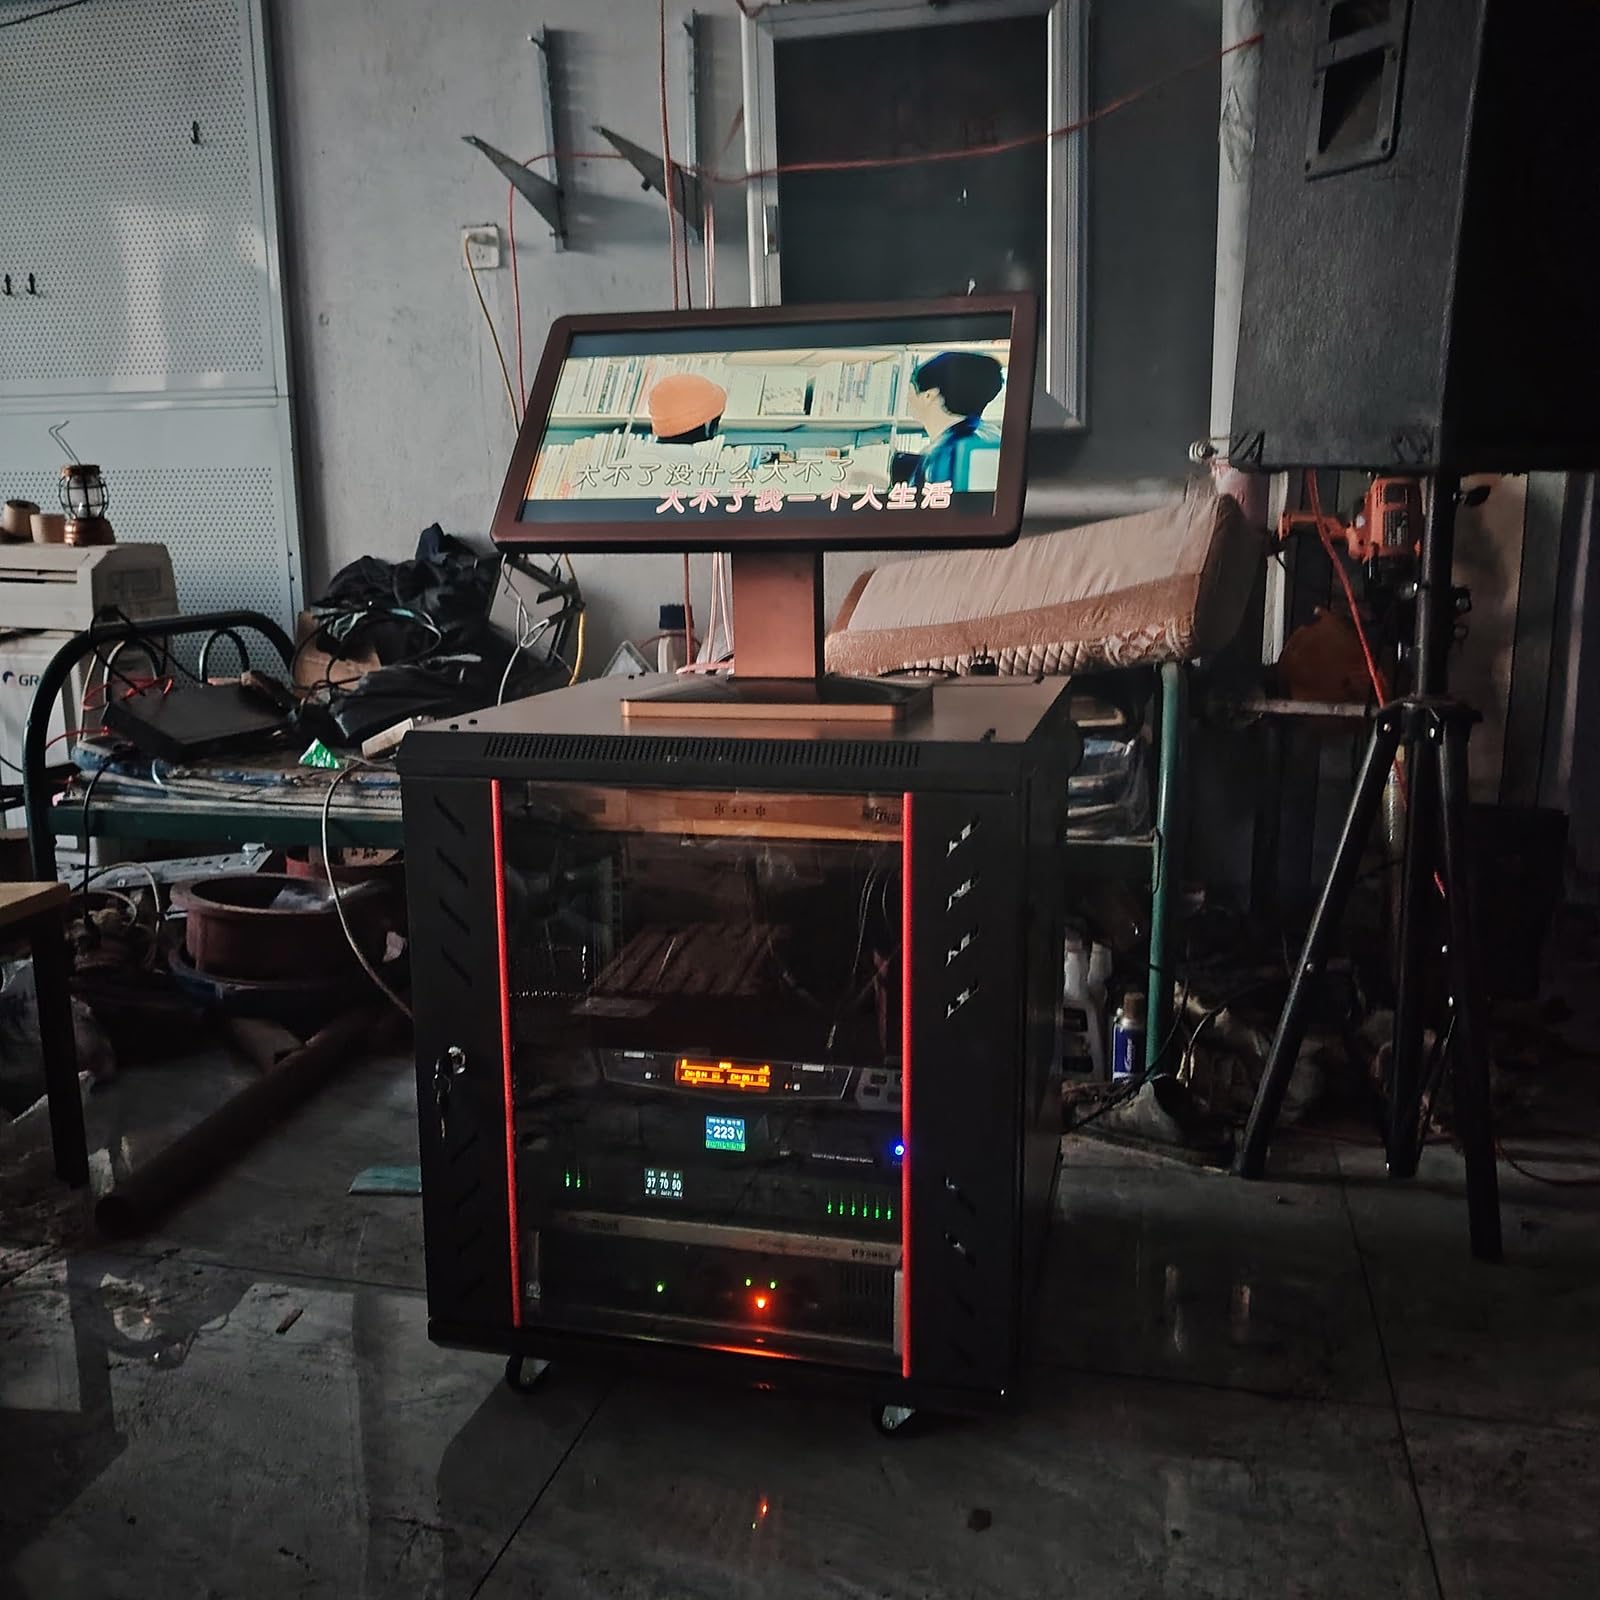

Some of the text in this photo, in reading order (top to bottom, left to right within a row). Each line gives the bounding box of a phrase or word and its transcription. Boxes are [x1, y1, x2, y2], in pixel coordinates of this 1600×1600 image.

[576, 458, 854, 487] 大不了没什么大不了
[655, 480, 953, 513] 大不了我一个人生活
[659, 1178, 669, 1190] 70
